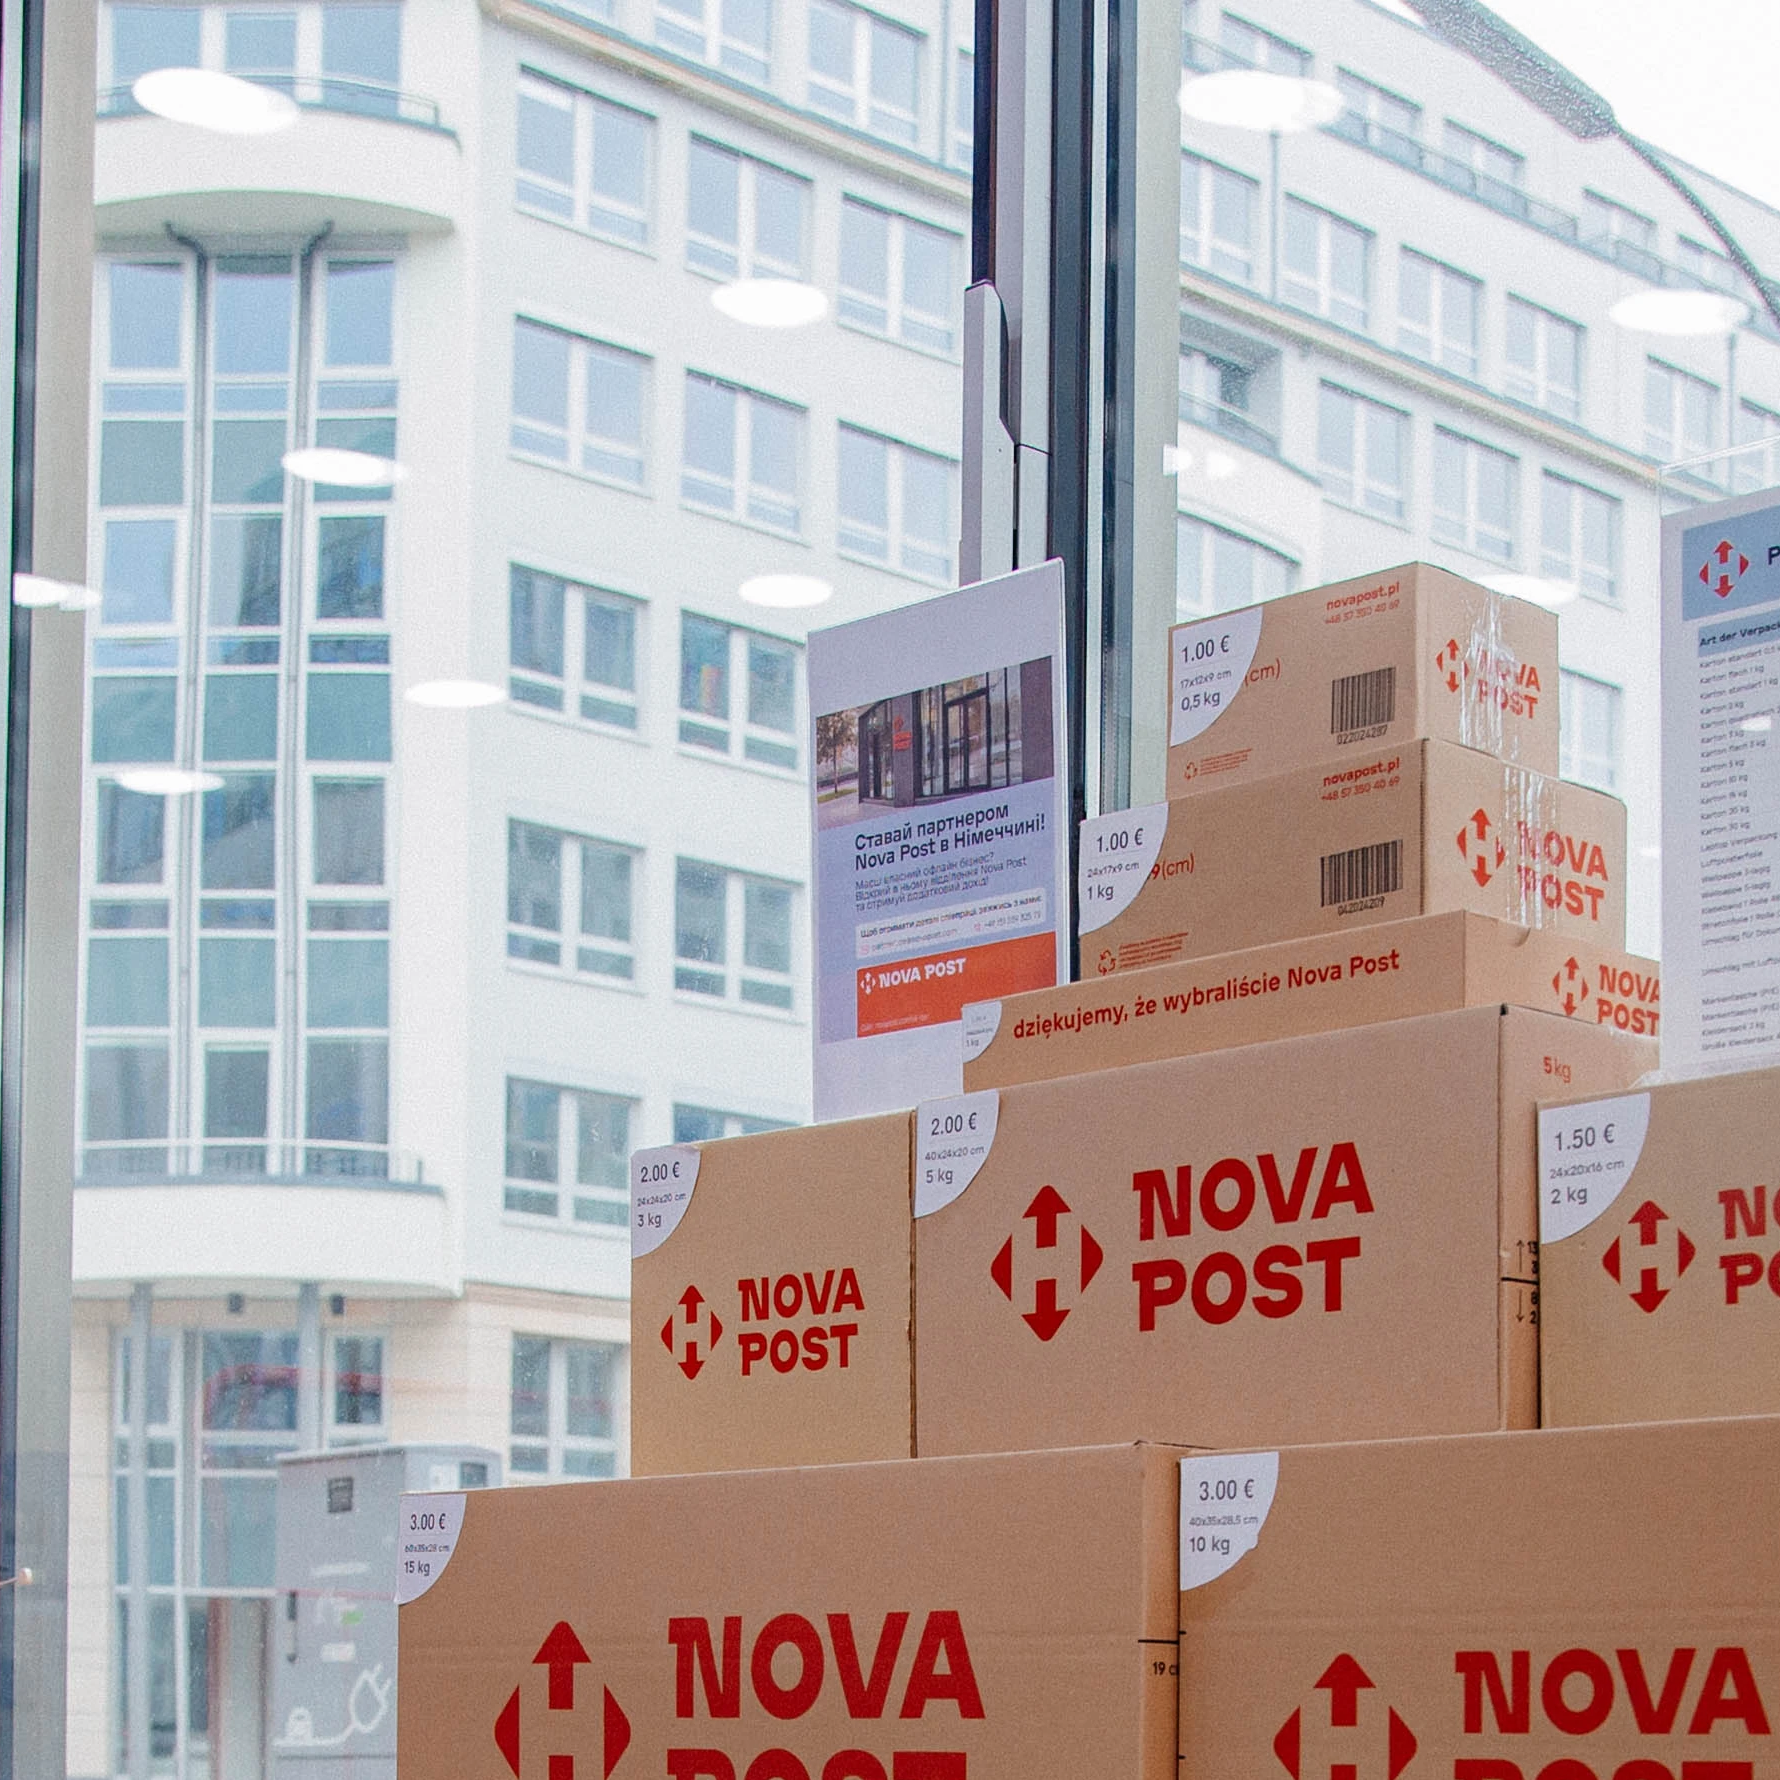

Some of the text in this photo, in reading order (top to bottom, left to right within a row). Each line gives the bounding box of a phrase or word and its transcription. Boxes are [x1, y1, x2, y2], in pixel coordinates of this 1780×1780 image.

[1326, 581, 1400, 611] novapost.pl
[1181, 635, 1230, 663] 1.00 €
[1700, 637, 1717, 647] Art
[1719, 632, 1737, 643] der
[1217, 669, 1232, 680] cm
[1181, 691, 1220, 712] 0,5 kg
[1323, 757, 1400, 787] novapost.pl
[855, 804, 1009, 851] Ставай партнером
[855, 814, 1046, 871] Nova Post в Німеччині!
[1097, 828, 1144, 852] 1.00 €
[1517, 821, 1608, 882] NOVA
[980, 863, 1004, 875] Nova
[1006, 856, 1027, 870] Post
[1125, 862, 1139, 871] cm
[1087, 885, 1114, 901] 1 kg
[1517, 864, 1604, 922] POST
[878, 958, 966, 989] NOVA POST
[1013, 949, 1400, 1040] dziękujemy, że wybraliście Nova Post
[931, 1112, 977, 1136] 2.00 €
[1555, 1123, 1615, 1151] 1.50 €
[970, 1146, 984, 1155] cm
[641, 1161, 680, 1182] 2.00 €
[926, 1168, 953, 1184] 5 kg
[1550, 1160, 1624, 1179] 24x20x16 cm
[1132, 1142, 1374, 1241] NOVA
[1551, 1186, 1588, 1205] 2 kg
[638, 1213, 661, 1228] 3 kg
[738, 1267, 864, 1322] NOVA
[1132, 1236, 1361, 1332] POST
[738, 1323, 858, 1376] POST
[1199, 1479, 1254, 1501] 3.00 €
[410, 1513, 446, 1530] 3.00 €
[1243, 1516, 1259, 1525] cm
[1190, 1535, 1230, 1555] 10 kg
[404, 1561, 430, 1576] 15 kg
[668, 1611, 985, 1720] NOVA
[1153, 1661, 1165, 1675] 19
[1455, 1647, 1771, 1735] NOVA
